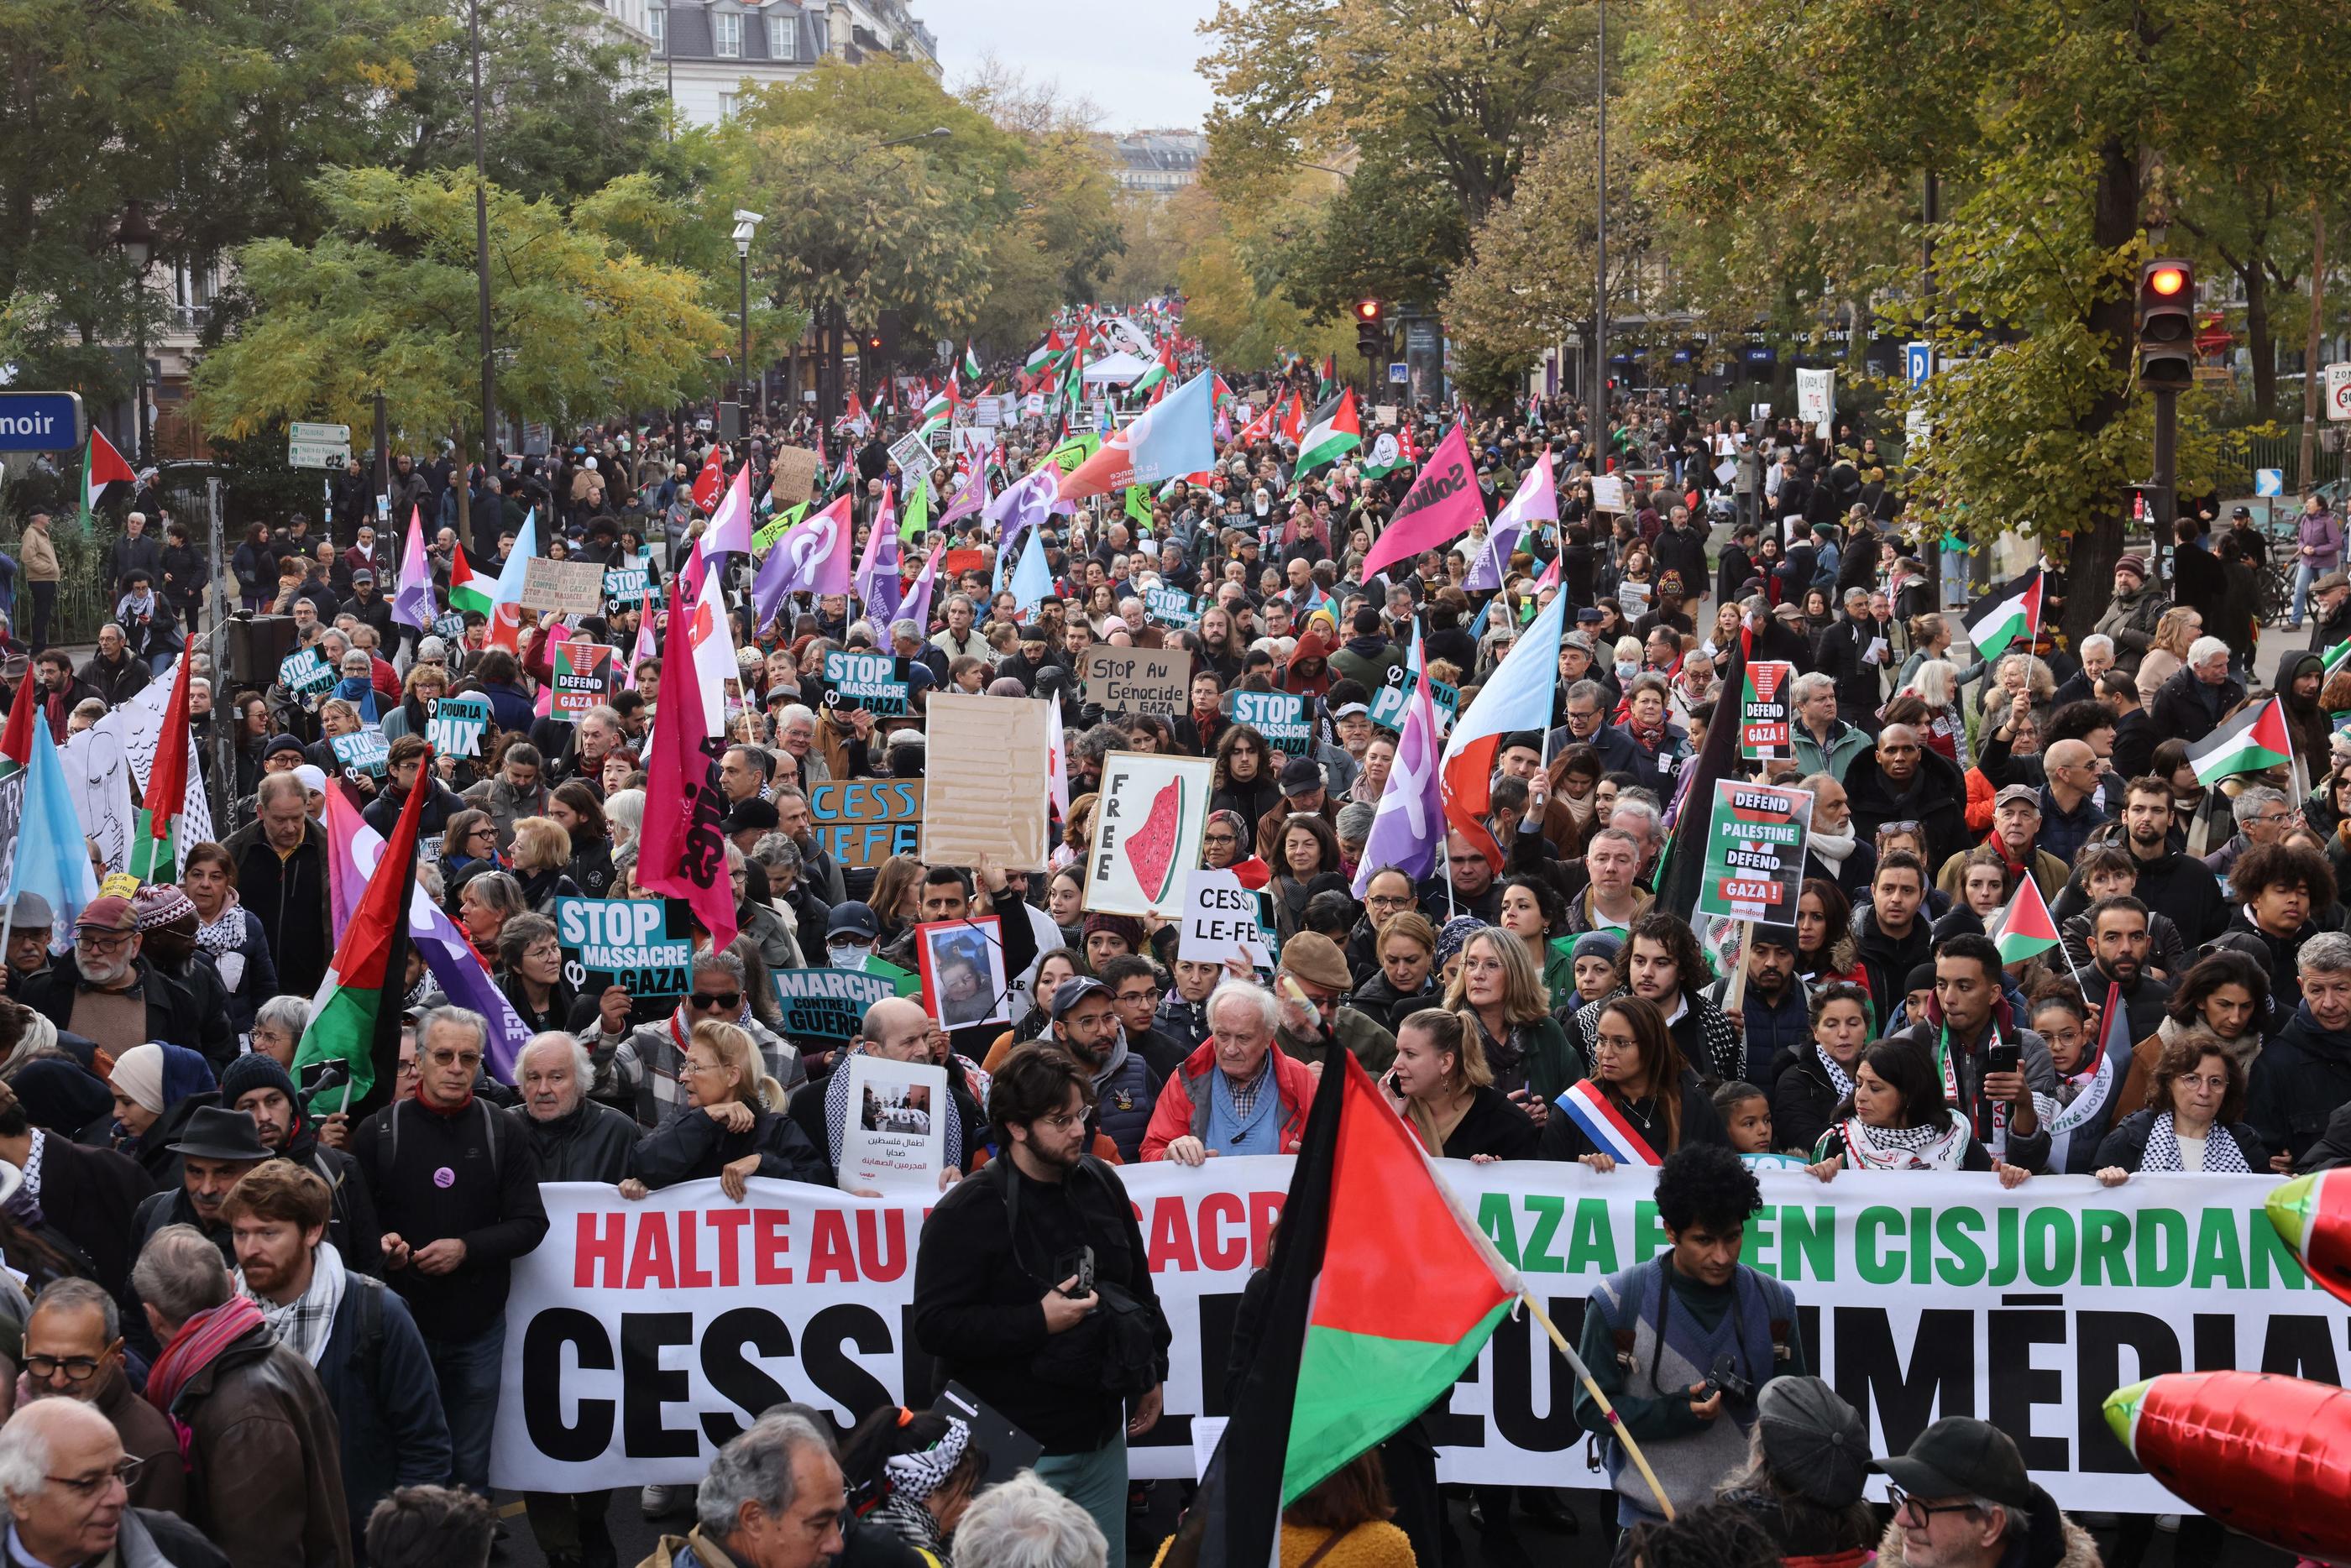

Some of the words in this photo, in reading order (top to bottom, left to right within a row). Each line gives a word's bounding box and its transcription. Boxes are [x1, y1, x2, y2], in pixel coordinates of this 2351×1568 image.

[1914, 354, 1924, 386] P
[2335, 371, 2351, 379] ZON
[0, 411, 54, 435] noir
[1223, 514, 1250, 524] STOP
[606, 571, 647, 593] STOP
[1148, 588, 1187, 611] STOP
[1155, 606, 1195, 621] MASSACRE
[435, 614, 464, 634] STO
[1167, 619, 1186, 629] GAZ
[280, 650, 316, 683] STOP
[827, 653, 893, 683] STOP
[293, 664, 332, 691] MASSACRE
[306, 675, 335, 696] GAZA
[559, 675, 603, 690] DEFEND
[840, 681, 906, 698] MASSACRE
[1407, 675, 1442, 700] PUR
[1442, 687, 1453, 705] LA
[441, 702, 467, 719] POUR
[468, 704, 481, 719] LA
[560, 696, 593, 708] GAZA
[862, 697, 903, 714] GAZA
[1139, 701, 1175, 715] GAZA
[1235, 694, 1301, 724] STOP
[1373, 685, 1453, 730] PAX
[1746, 703, 1784, 718] DEFEND
[428, 719, 482, 756] PAIX
[1249, 723, 1311, 739] MASSACRE
[1748, 728, 1777, 742] GAZA
[1780, 727, 1784, 740] !
[335, 734, 375, 759] STO
[1272, 738, 1306, 756] GAZA
[351, 749, 390, 766] MASSAC
[812, 783, 917, 820] CESS
[1736, 792, 1788, 812] DEFEND
[1097, 773, 1129, 881] FREE
[1722, 823, 1794, 842] PALESTINE
[1727, 851, 1781, 870] DEFEND
[106, 886, 132, 894] NOCIDE
[1199, 888, 1251, 911] CESS
[1726, 882, 1767, 898] GAZA
[1772, 886, 1778, 900] !
[1731, 907, 1764, 917] samidoun
[562, 900, 661, 946] STOP
[583, 944, 689, 967] MASSACRE
[620, 968, 689, 995] GAZA
[776, 972, 896, 1005] MARCHE
[793, 997, 841, 1010] CONTRE
[843, 1000, 858, 1014] LA
[788, 1010, 863, 1037] GUERR
[868, 1137, 901, 1146] فلسطين
[902, 1138, 924, 1147] أطفال
[861, 1158, 893, 1167] الصهاينة
[886, 1148, 906, 1158] ضحايا
[894, 1163, 927, 1171] المجرمين
[573, 1209, 793, 1289] HALTE
[806, 1207, 908, 1284] AU
[1475, 1192, 1620, 1273] AZA
[1854, 1205, 2321, 1290] CISJORDAN
[523, 1303, 915, 1463] CESS
